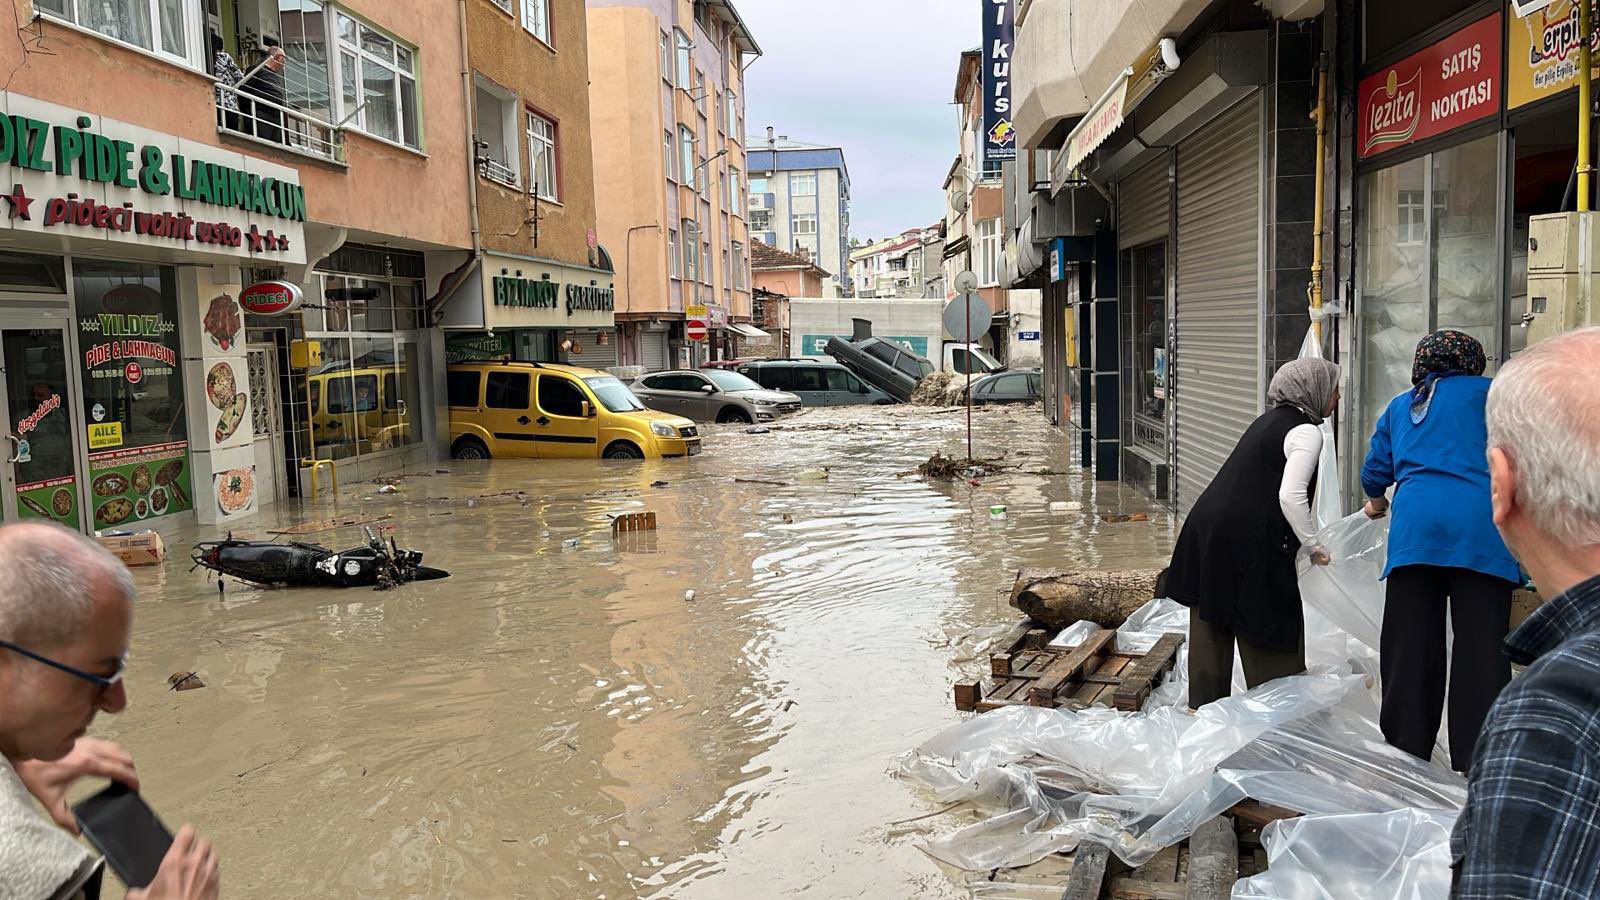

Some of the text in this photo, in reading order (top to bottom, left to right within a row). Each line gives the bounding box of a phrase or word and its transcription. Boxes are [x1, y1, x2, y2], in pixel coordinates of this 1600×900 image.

[992, 39, 1010, 112] kurs
[1442, 43, 1481, 79] SATIŞ
[1369, 89, 1415, 133] lezita
[1431, 79, 1492, 122] NOKTASI
[53, 115, 137, 188] PİDE
[138, 145, 171, 195] &
[171, 154, 306, 221] LAHMACUN
[43, 193, 241, 247] pideci vahit usta
[245, 290, 289, 306] PİDECİ
[492, 268, 560, 308] BİZİMKÖY
[98, 314, 160, 336] YILDIZ
[86, 340, 176, 369] PİDE & LAHMACUN
[95, 425, 116, 437] AİLE
